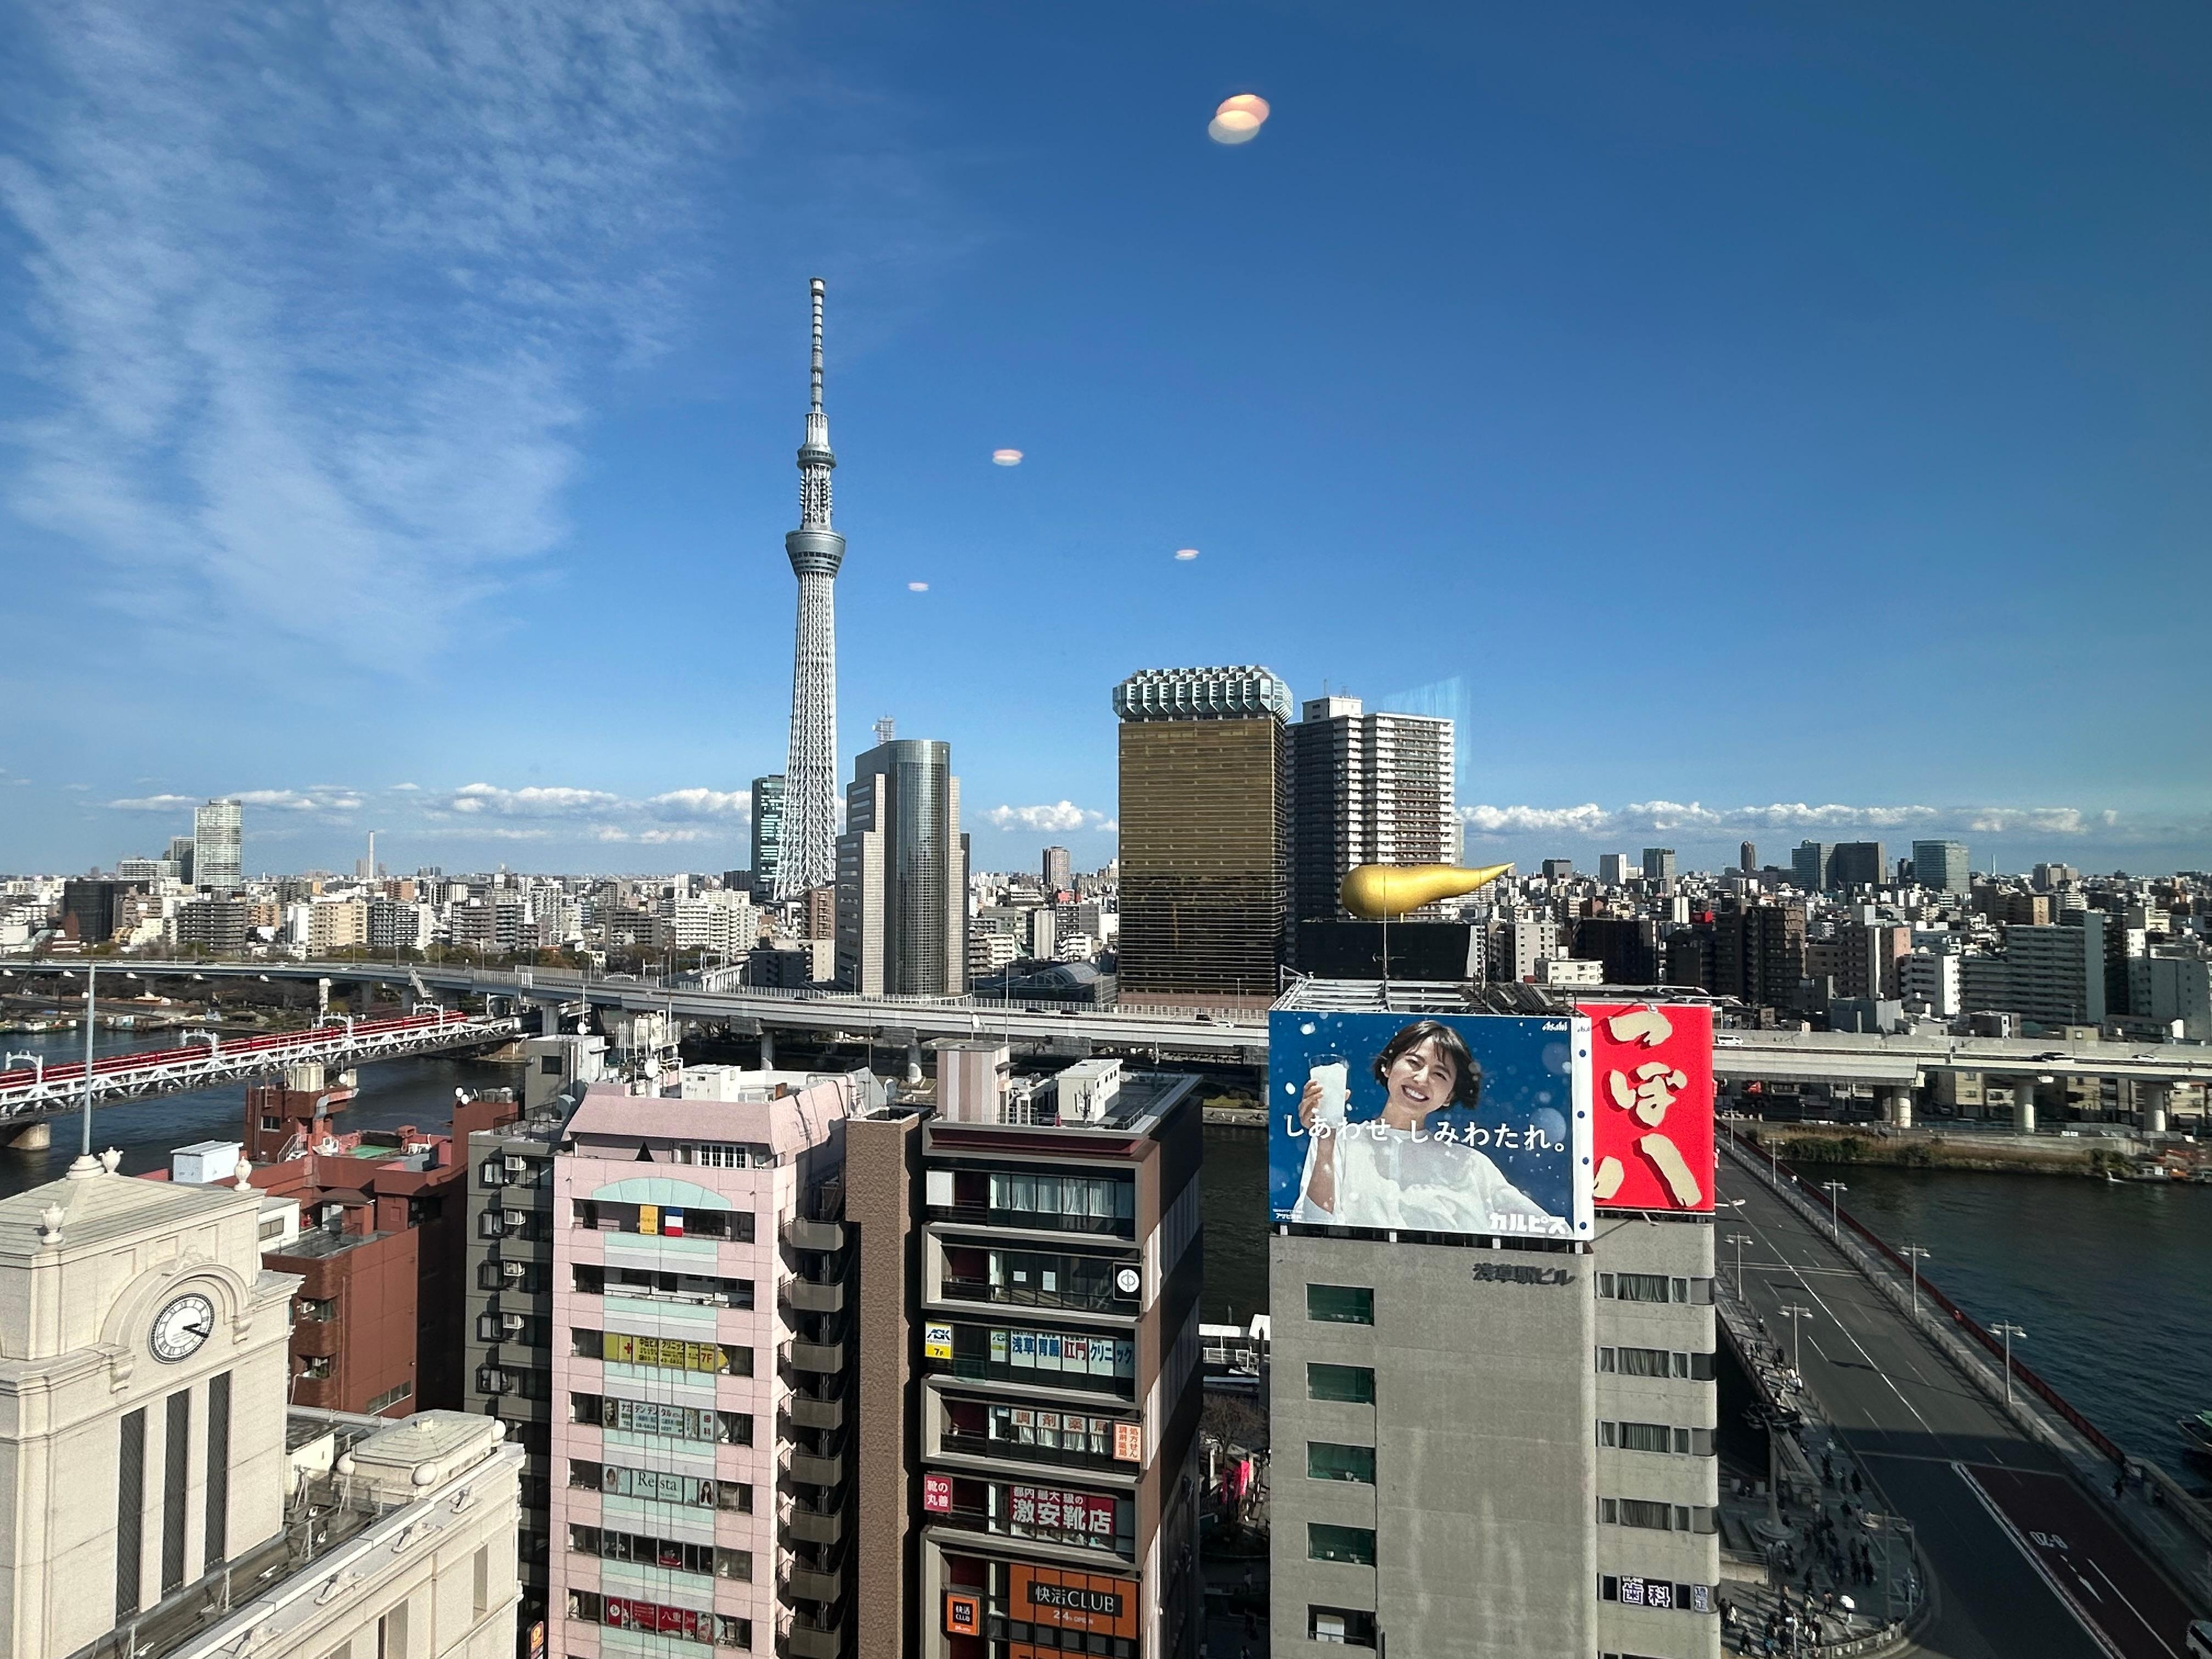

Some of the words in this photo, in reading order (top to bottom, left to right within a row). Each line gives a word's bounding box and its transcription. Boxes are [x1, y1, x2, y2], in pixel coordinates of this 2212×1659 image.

[1542, 1021, 1567, 1031] Asahi
[1286, 1114, 1565, 1153] しあわせ、しみわたれ。
[1489, 1212, 1566, 1234] カルピス
[1472, 1263, 1576, 1285] 浅草駅ビル
[702, 1353, 713, 1363] 7F
[1013, 1498, 1111, 1534] 激安靴店
[1622, 1582, 1671, 1607] 歯科
